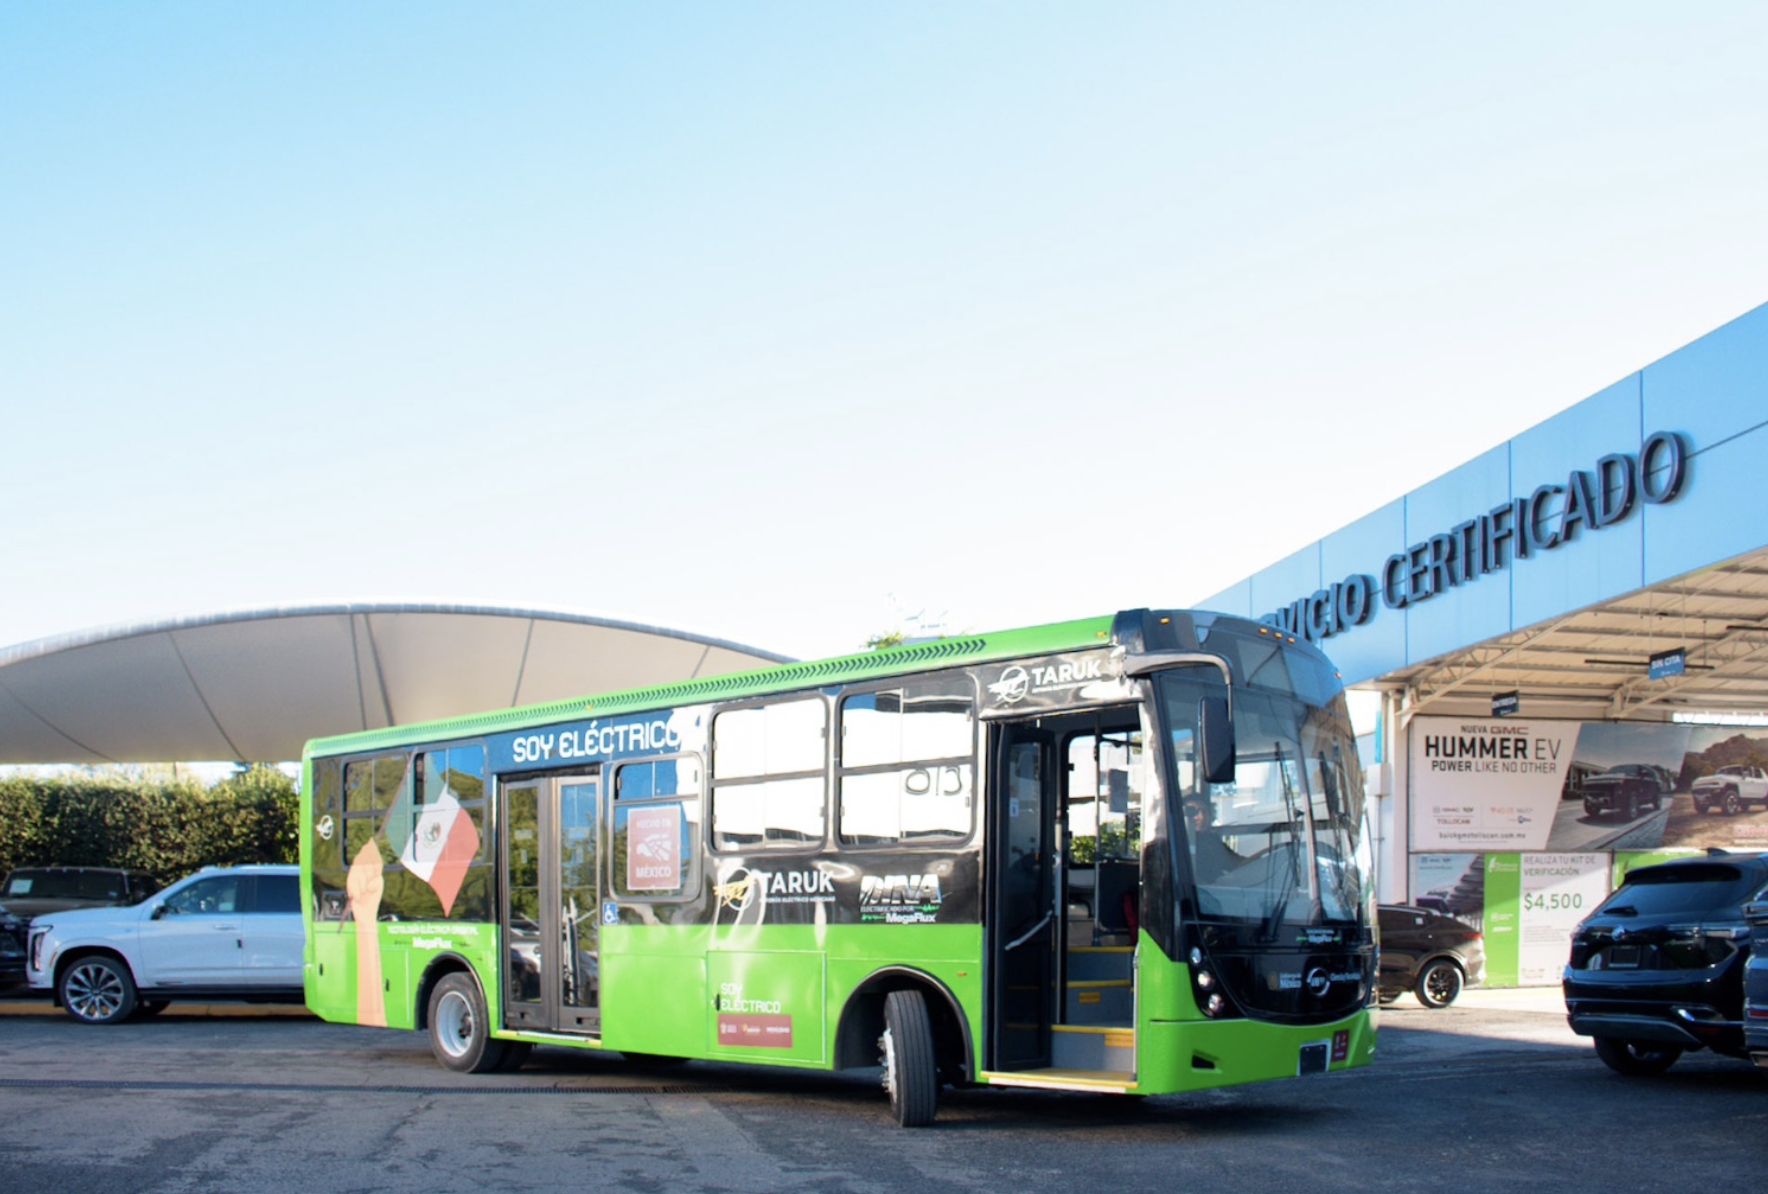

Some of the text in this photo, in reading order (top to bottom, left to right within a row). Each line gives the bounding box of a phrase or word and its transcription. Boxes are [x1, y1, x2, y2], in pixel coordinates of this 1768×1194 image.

[1382, 431, 1686, 609] CERTIFICADO
[1031, 659, 1102, 686] TARUK
[1460, 726, 1529, 735] NUEVA GMC
[513, 733, 554, 762] SOY
[1425, 735, 1561, 760] HUMMER EV
[1431, 760, 1557, 774] POWER LIKE NO OTHER
[1524, 855, 1558, 865] REALIZA
[1559, 855, 1569, 865] TU
[1570, 855, 1584, 864] KIT
[758, 871, 835, 894] TARUK
[1523, 892, 1583, 911] $4,500
[886, 912, 937, 924] MegaFlux
[721, 983, 742, 996] SOY
